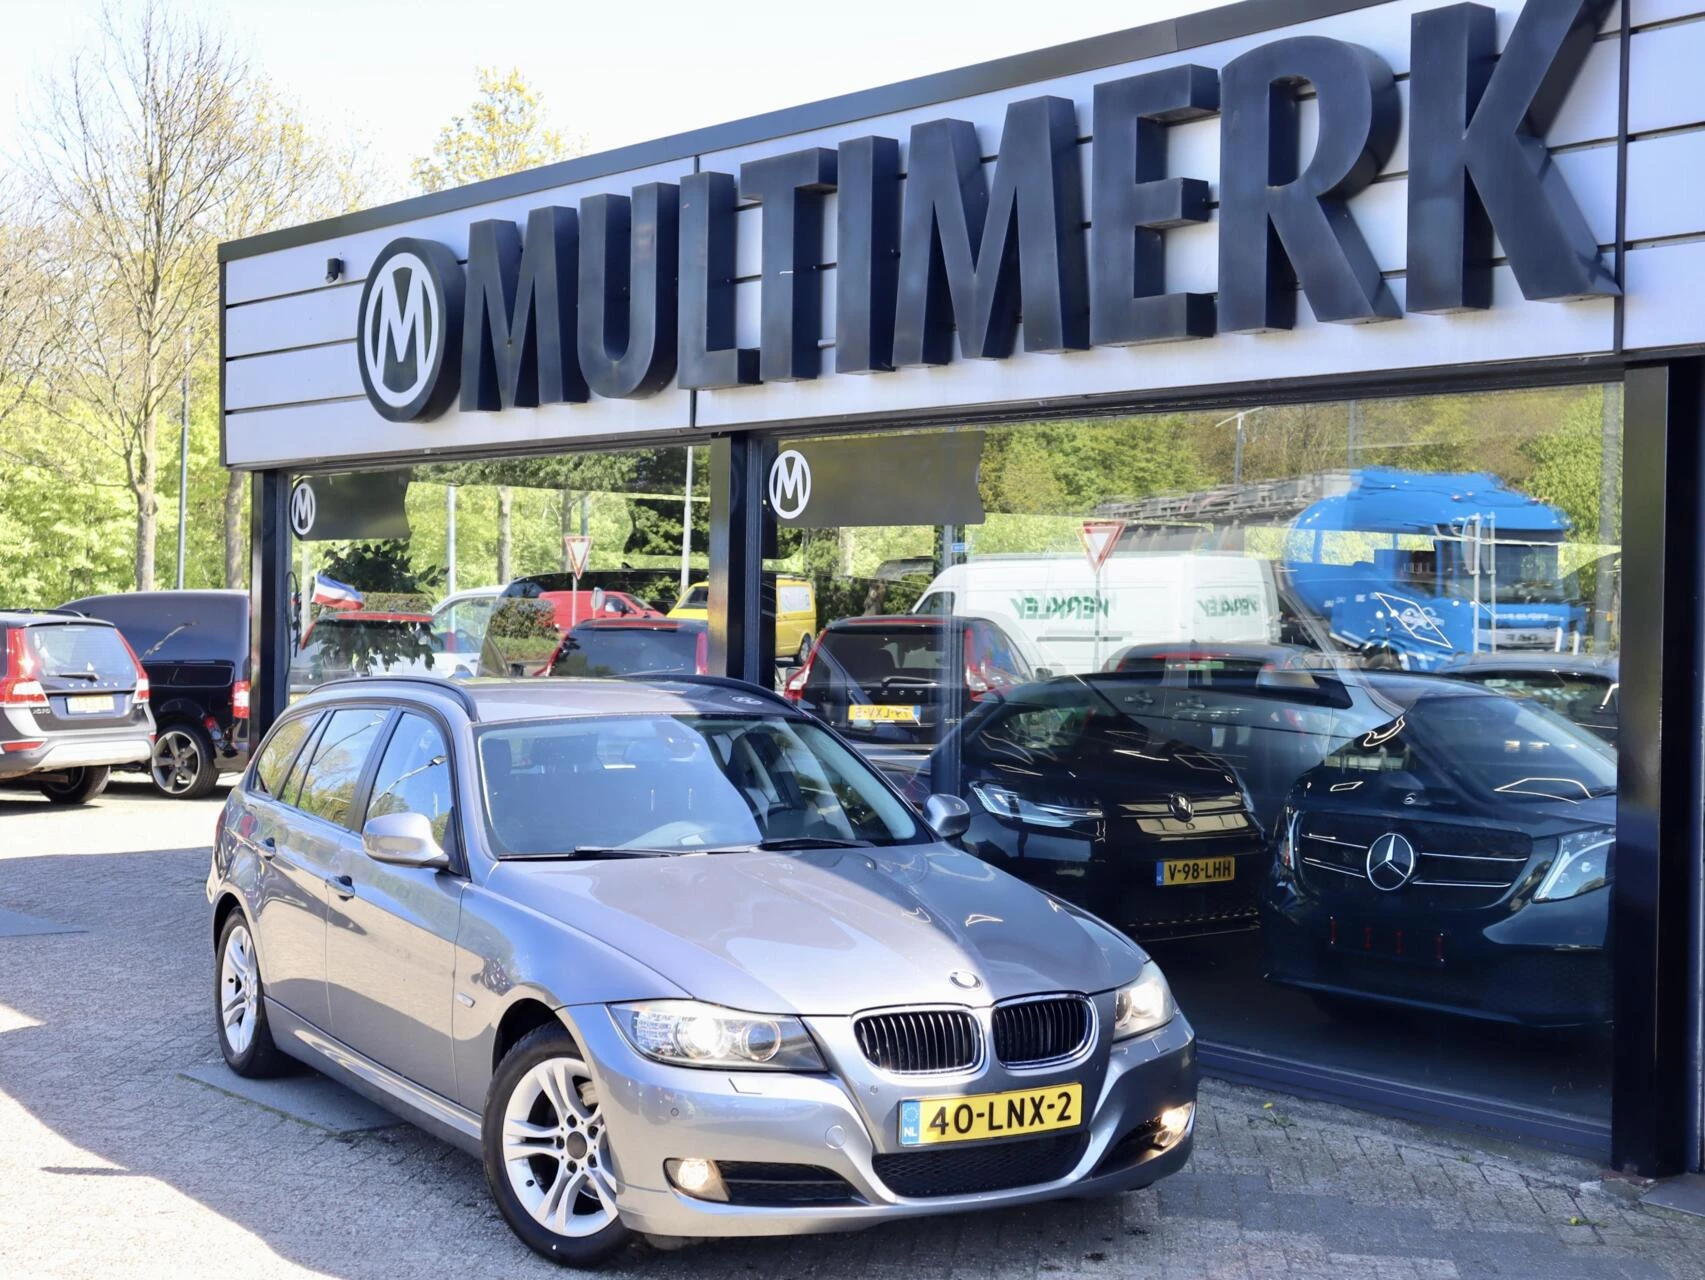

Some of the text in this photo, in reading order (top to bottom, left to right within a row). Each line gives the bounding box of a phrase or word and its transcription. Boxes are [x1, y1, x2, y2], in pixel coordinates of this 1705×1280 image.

[364, 0, 1622, 413] M MULTIMERK
[1168, 861, 1231, 881] V-98-LHH
[904, 1091, 1072, 1137] NL 40-LNX-2
